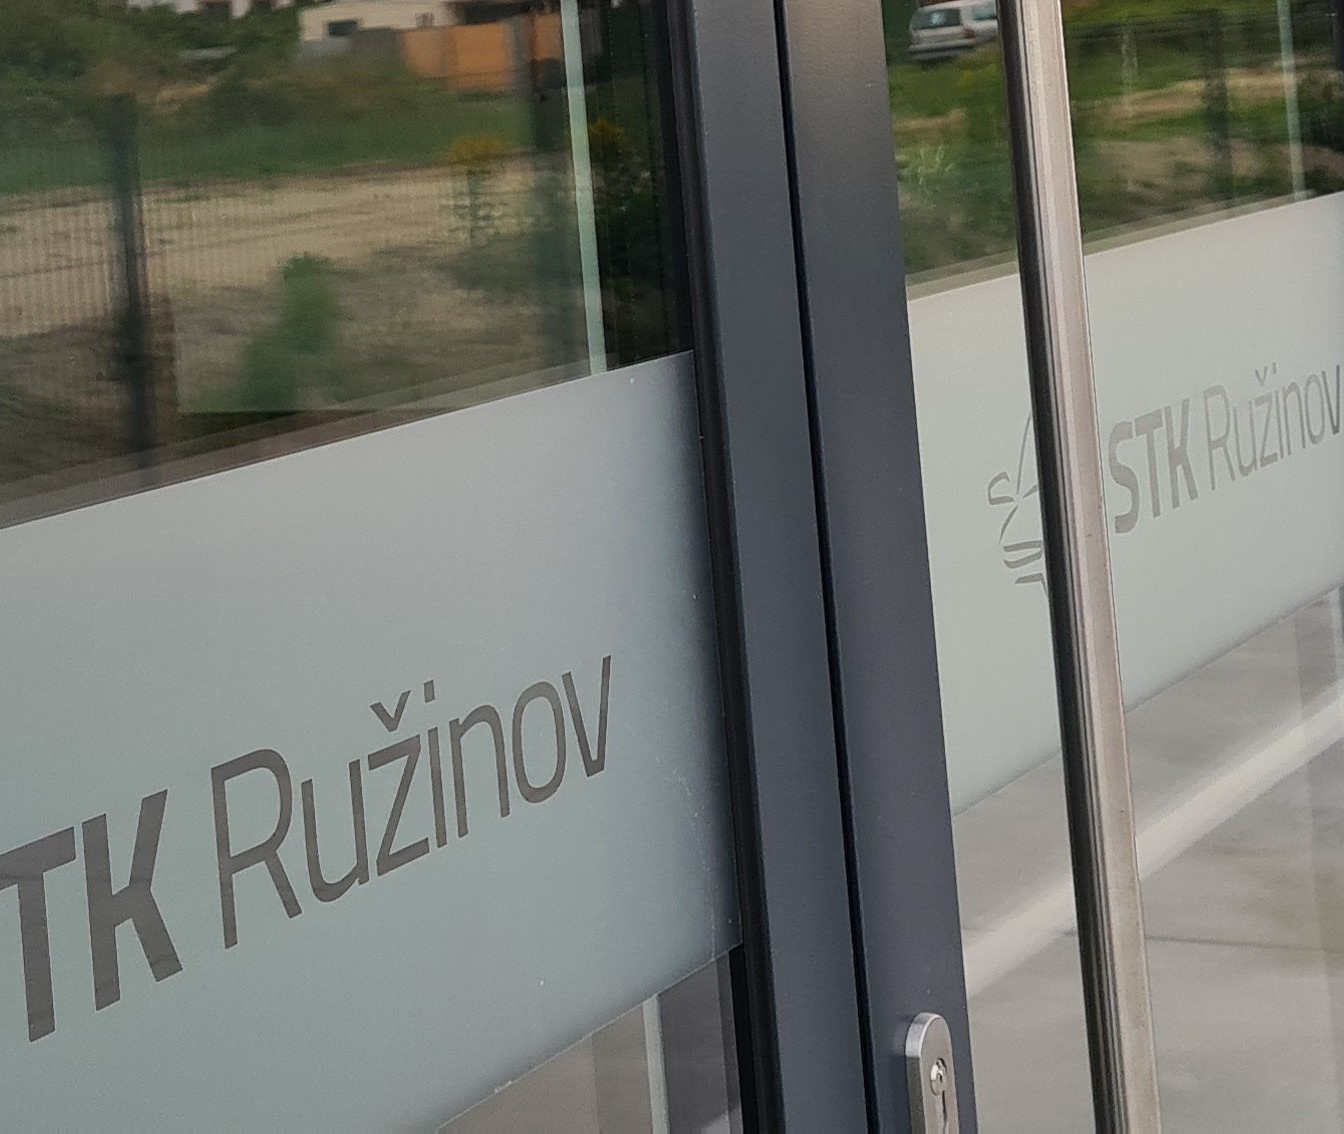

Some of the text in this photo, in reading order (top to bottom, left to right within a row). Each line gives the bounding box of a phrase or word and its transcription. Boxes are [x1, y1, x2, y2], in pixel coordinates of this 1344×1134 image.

[1108, 363, 1341, 534] STK Ružinov
[210, 655, 612, 950] Ružinov
